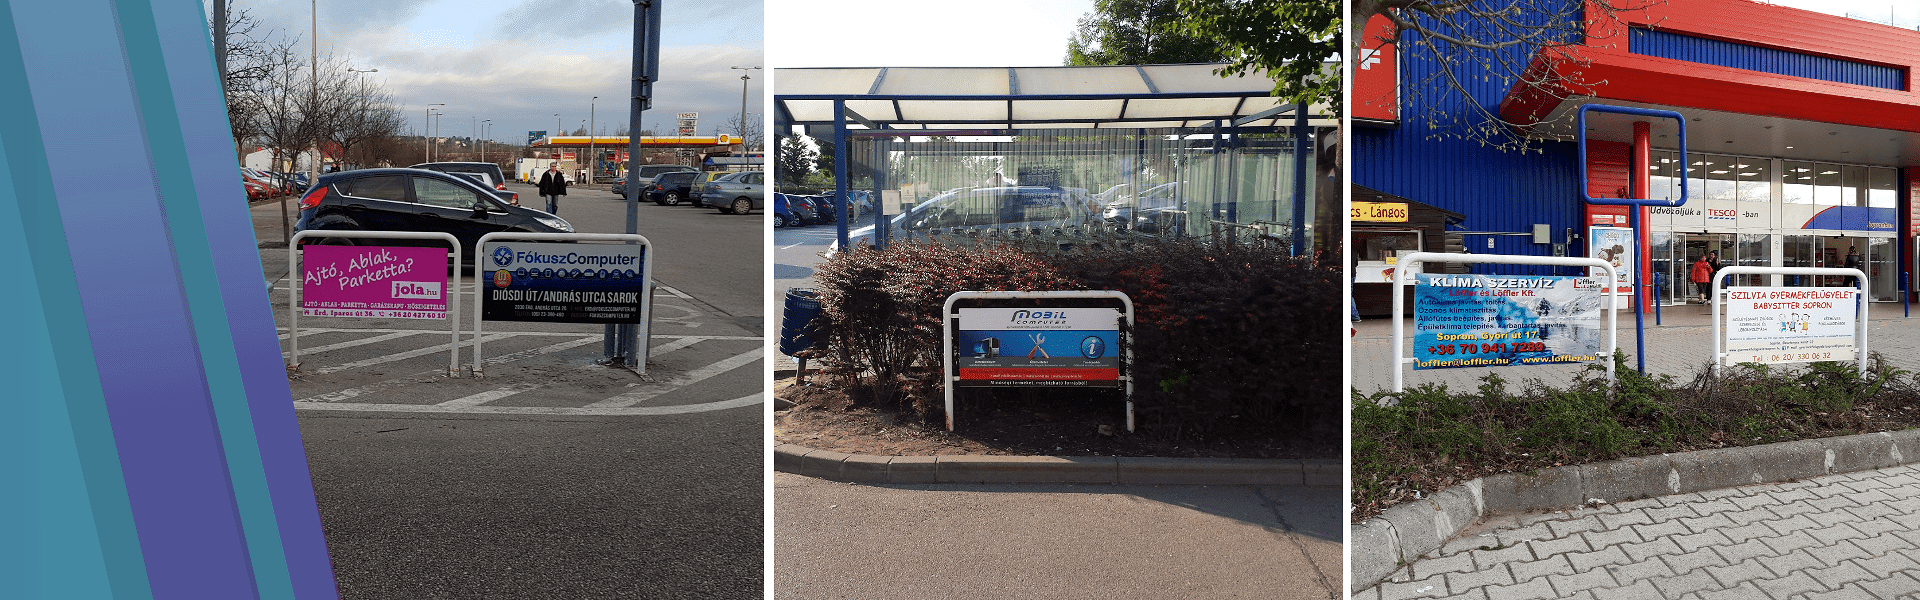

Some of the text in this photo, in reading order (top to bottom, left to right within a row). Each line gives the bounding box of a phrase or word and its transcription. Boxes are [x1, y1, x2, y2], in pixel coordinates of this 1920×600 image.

[1370, 206, 1406, 218] Lángos
[516, 251, 636, 267] FókuszComputer
[305, 248, 397, 286] Ajtó, Ablak,
[339, 258, 414, 290] Parketta?
[1430, 276, 1554, 288] KLÍMA SZERVÍZ
[394, 283, 438, 297] jola.hu
[493, 288, 638, 304] DIÓSDI ÚT/ANDRÁS UTCA SAROK
[1731, 292, 1766, 300] SZILVIA
[1436, 332, 1478, 342] Sopron,
[1512, 330, 1522, 339] út
[1428, 342, 1544, 354] +36 70 941 7289
[1417, 355, 1596, 368] loffler@loffler.hu www.loffler.hu
